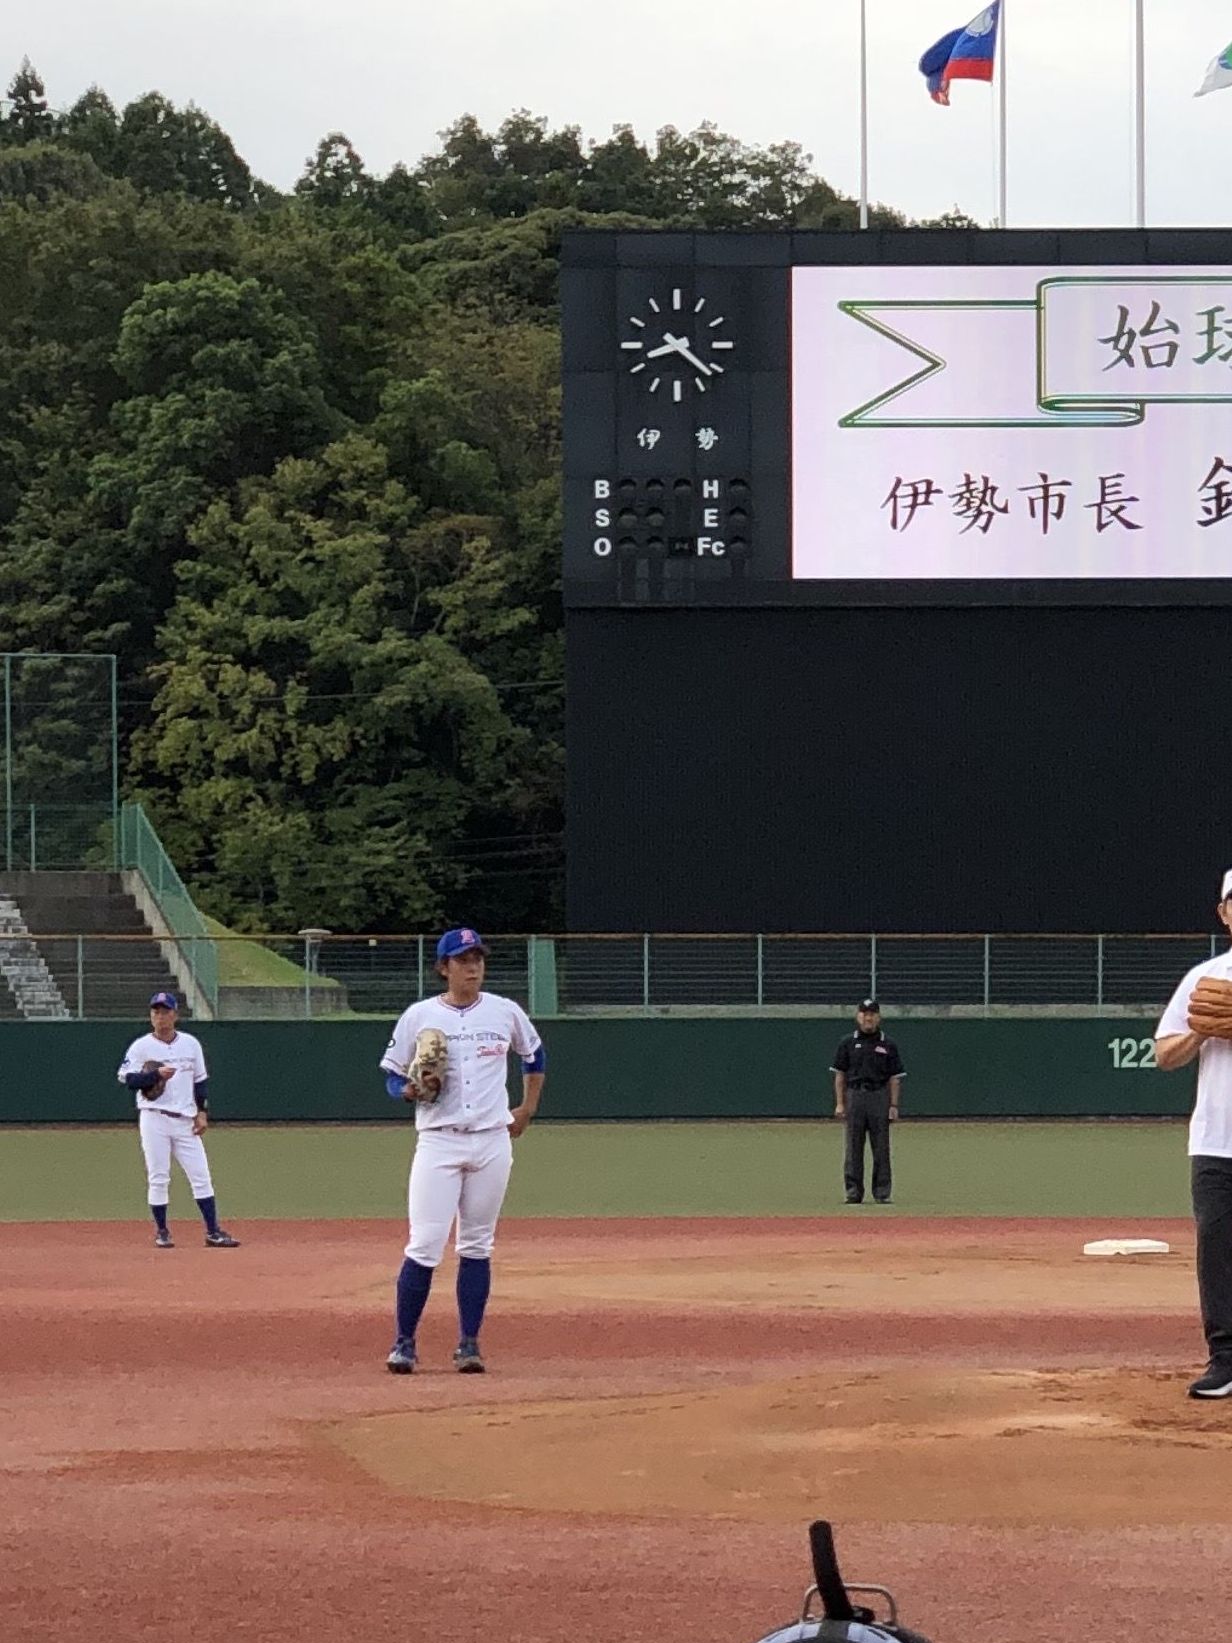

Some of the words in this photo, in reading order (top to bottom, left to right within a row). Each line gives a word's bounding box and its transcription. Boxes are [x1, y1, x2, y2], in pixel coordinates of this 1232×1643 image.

[594, 479, 610, 499] B
[702, 479, 719, 499] H
[883, 472, 1144, 535] 伊勢市長
[595, 508, 611, 528] S
[703, 508, 719, 528] E
[1107, 1037, 1157, 1068] 122
